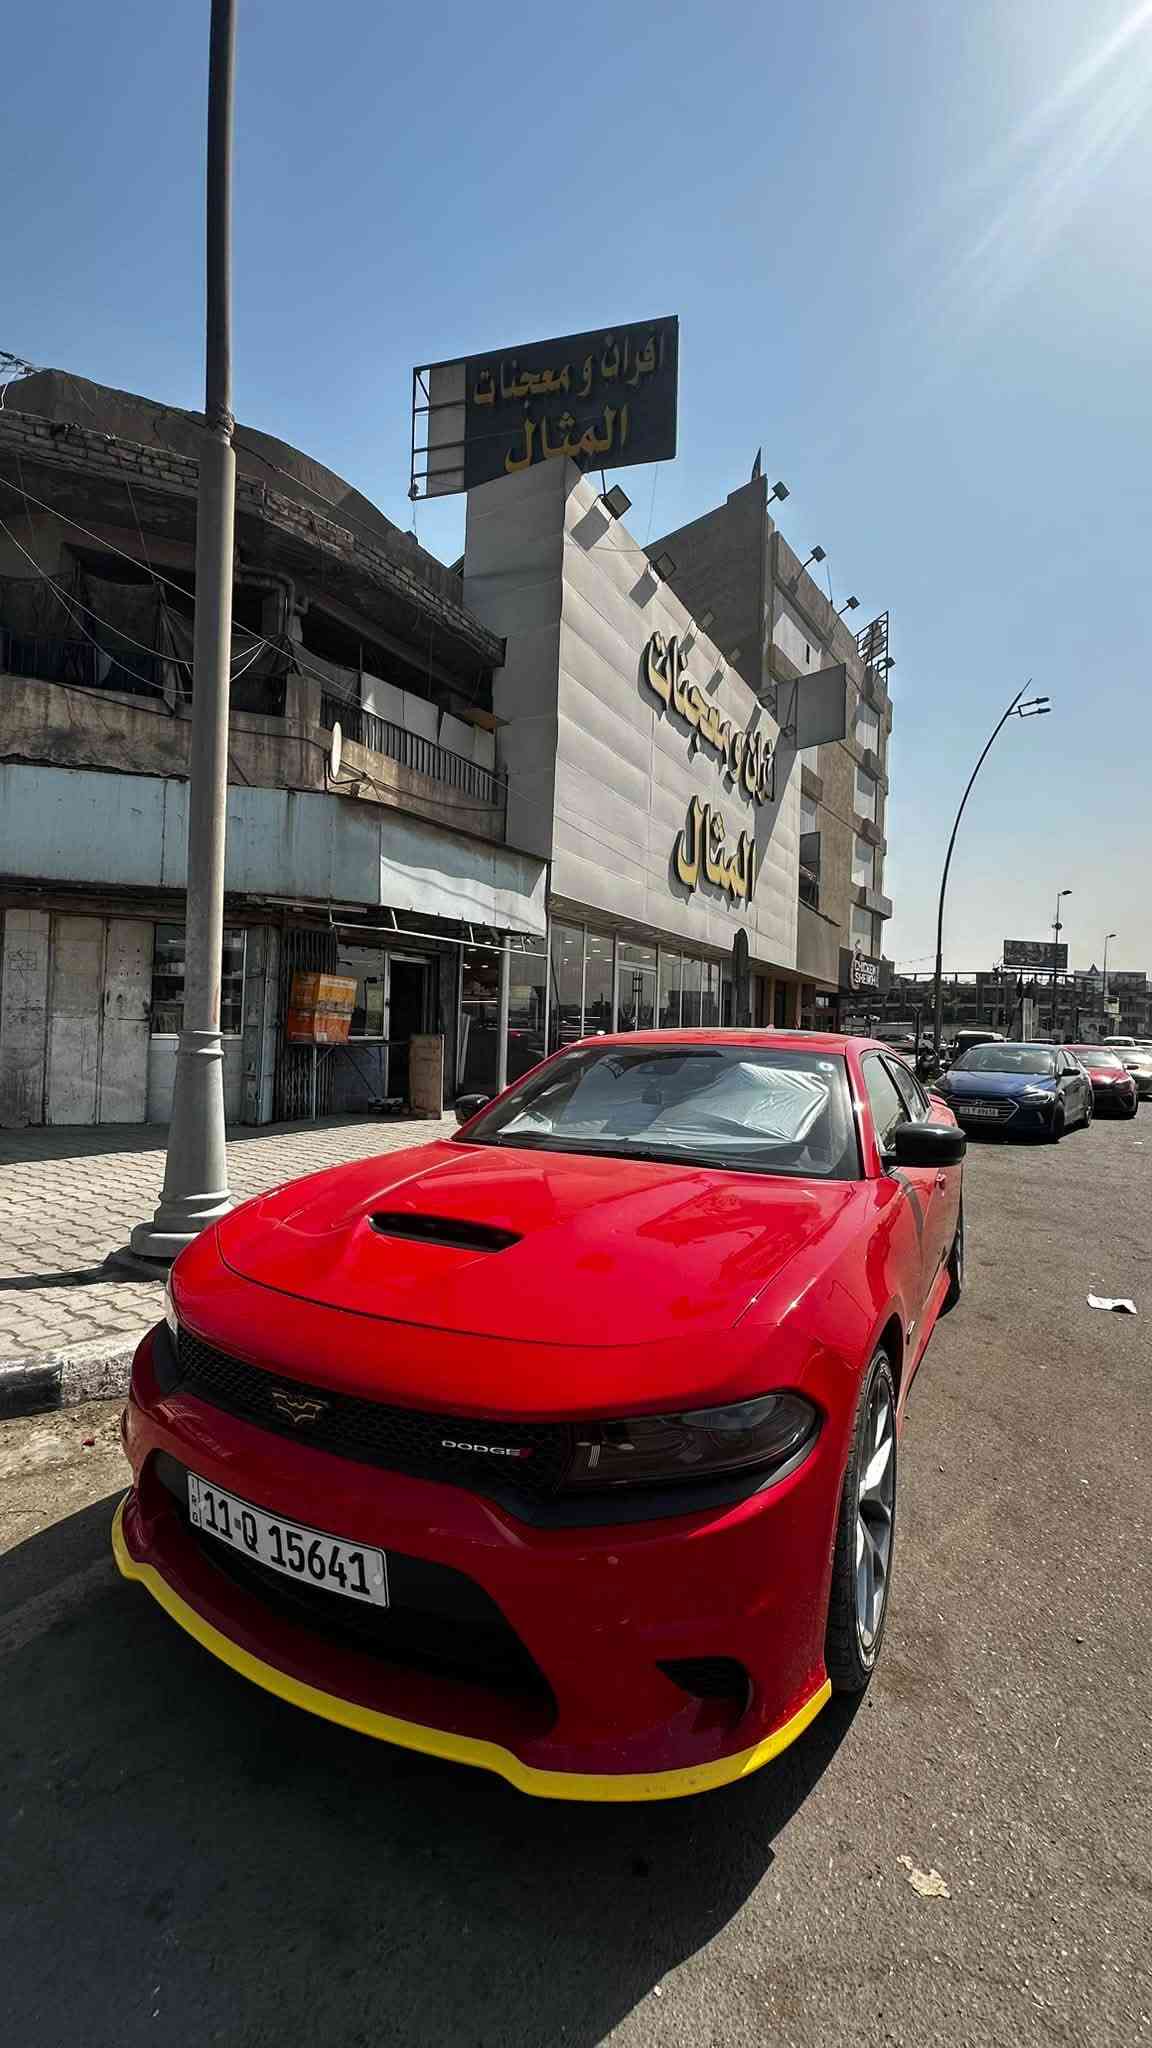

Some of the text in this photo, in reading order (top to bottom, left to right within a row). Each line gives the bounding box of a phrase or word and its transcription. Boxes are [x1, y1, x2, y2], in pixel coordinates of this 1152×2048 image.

[473, 359, 572, 406] معجنات
[576, 354, 594, 397] و
[505, 402, 630, 473] المثال
[673, 796, 756, 901] المثال
[441, 1440, 521, 1456] DODGE
[204, 1490, 371, 1595] 11-Q 15641
